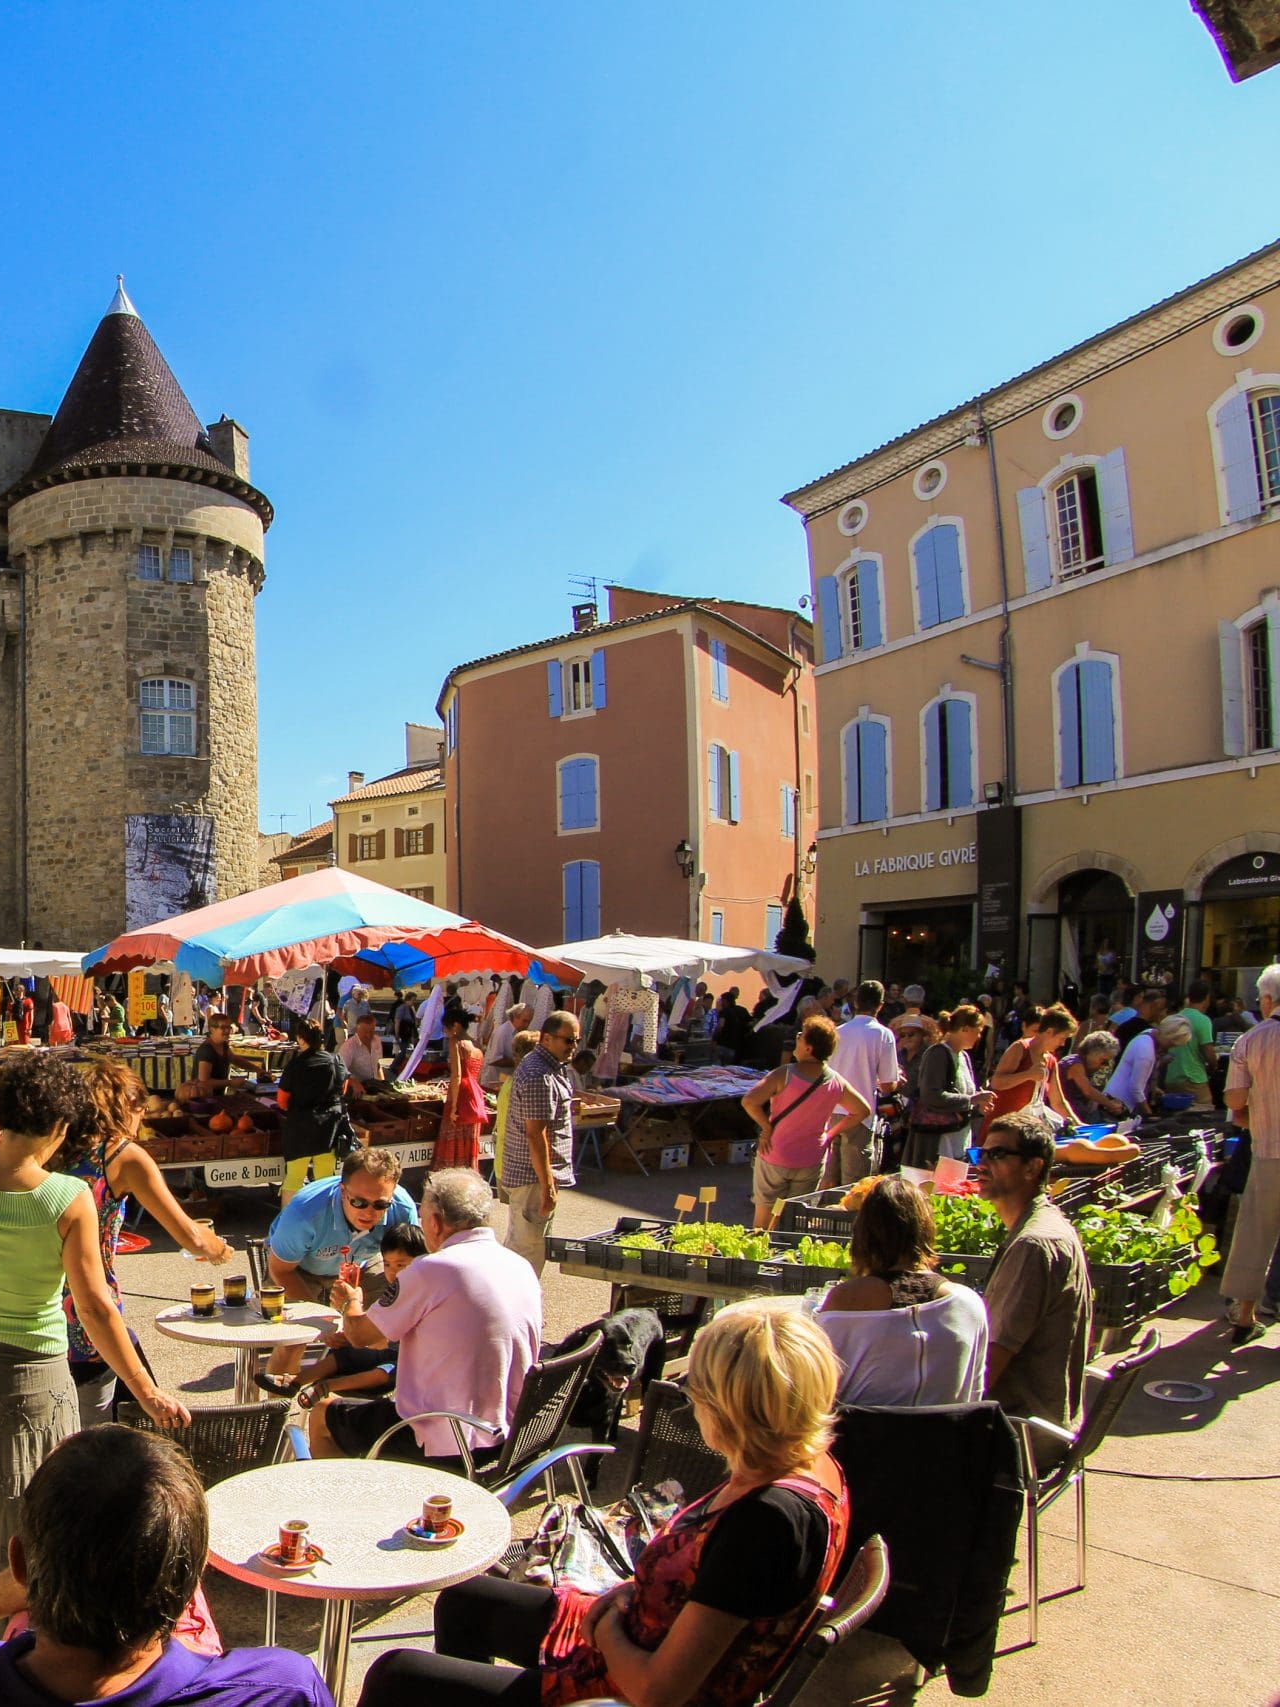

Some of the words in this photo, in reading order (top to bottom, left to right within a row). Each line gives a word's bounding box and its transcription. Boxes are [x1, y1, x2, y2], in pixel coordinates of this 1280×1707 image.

[855, 861, 870, 876] LA
[874, 852, 935, 874] FABRIQUE
[939, 842, 977, 866] GIVRÉ
[408, 1149, 433, 1162] AUBE
[210, 1168, 237, 1182] Gene
[241, 1166, 250, 1180] &
[254, 1164, 280, 1178] Domi
